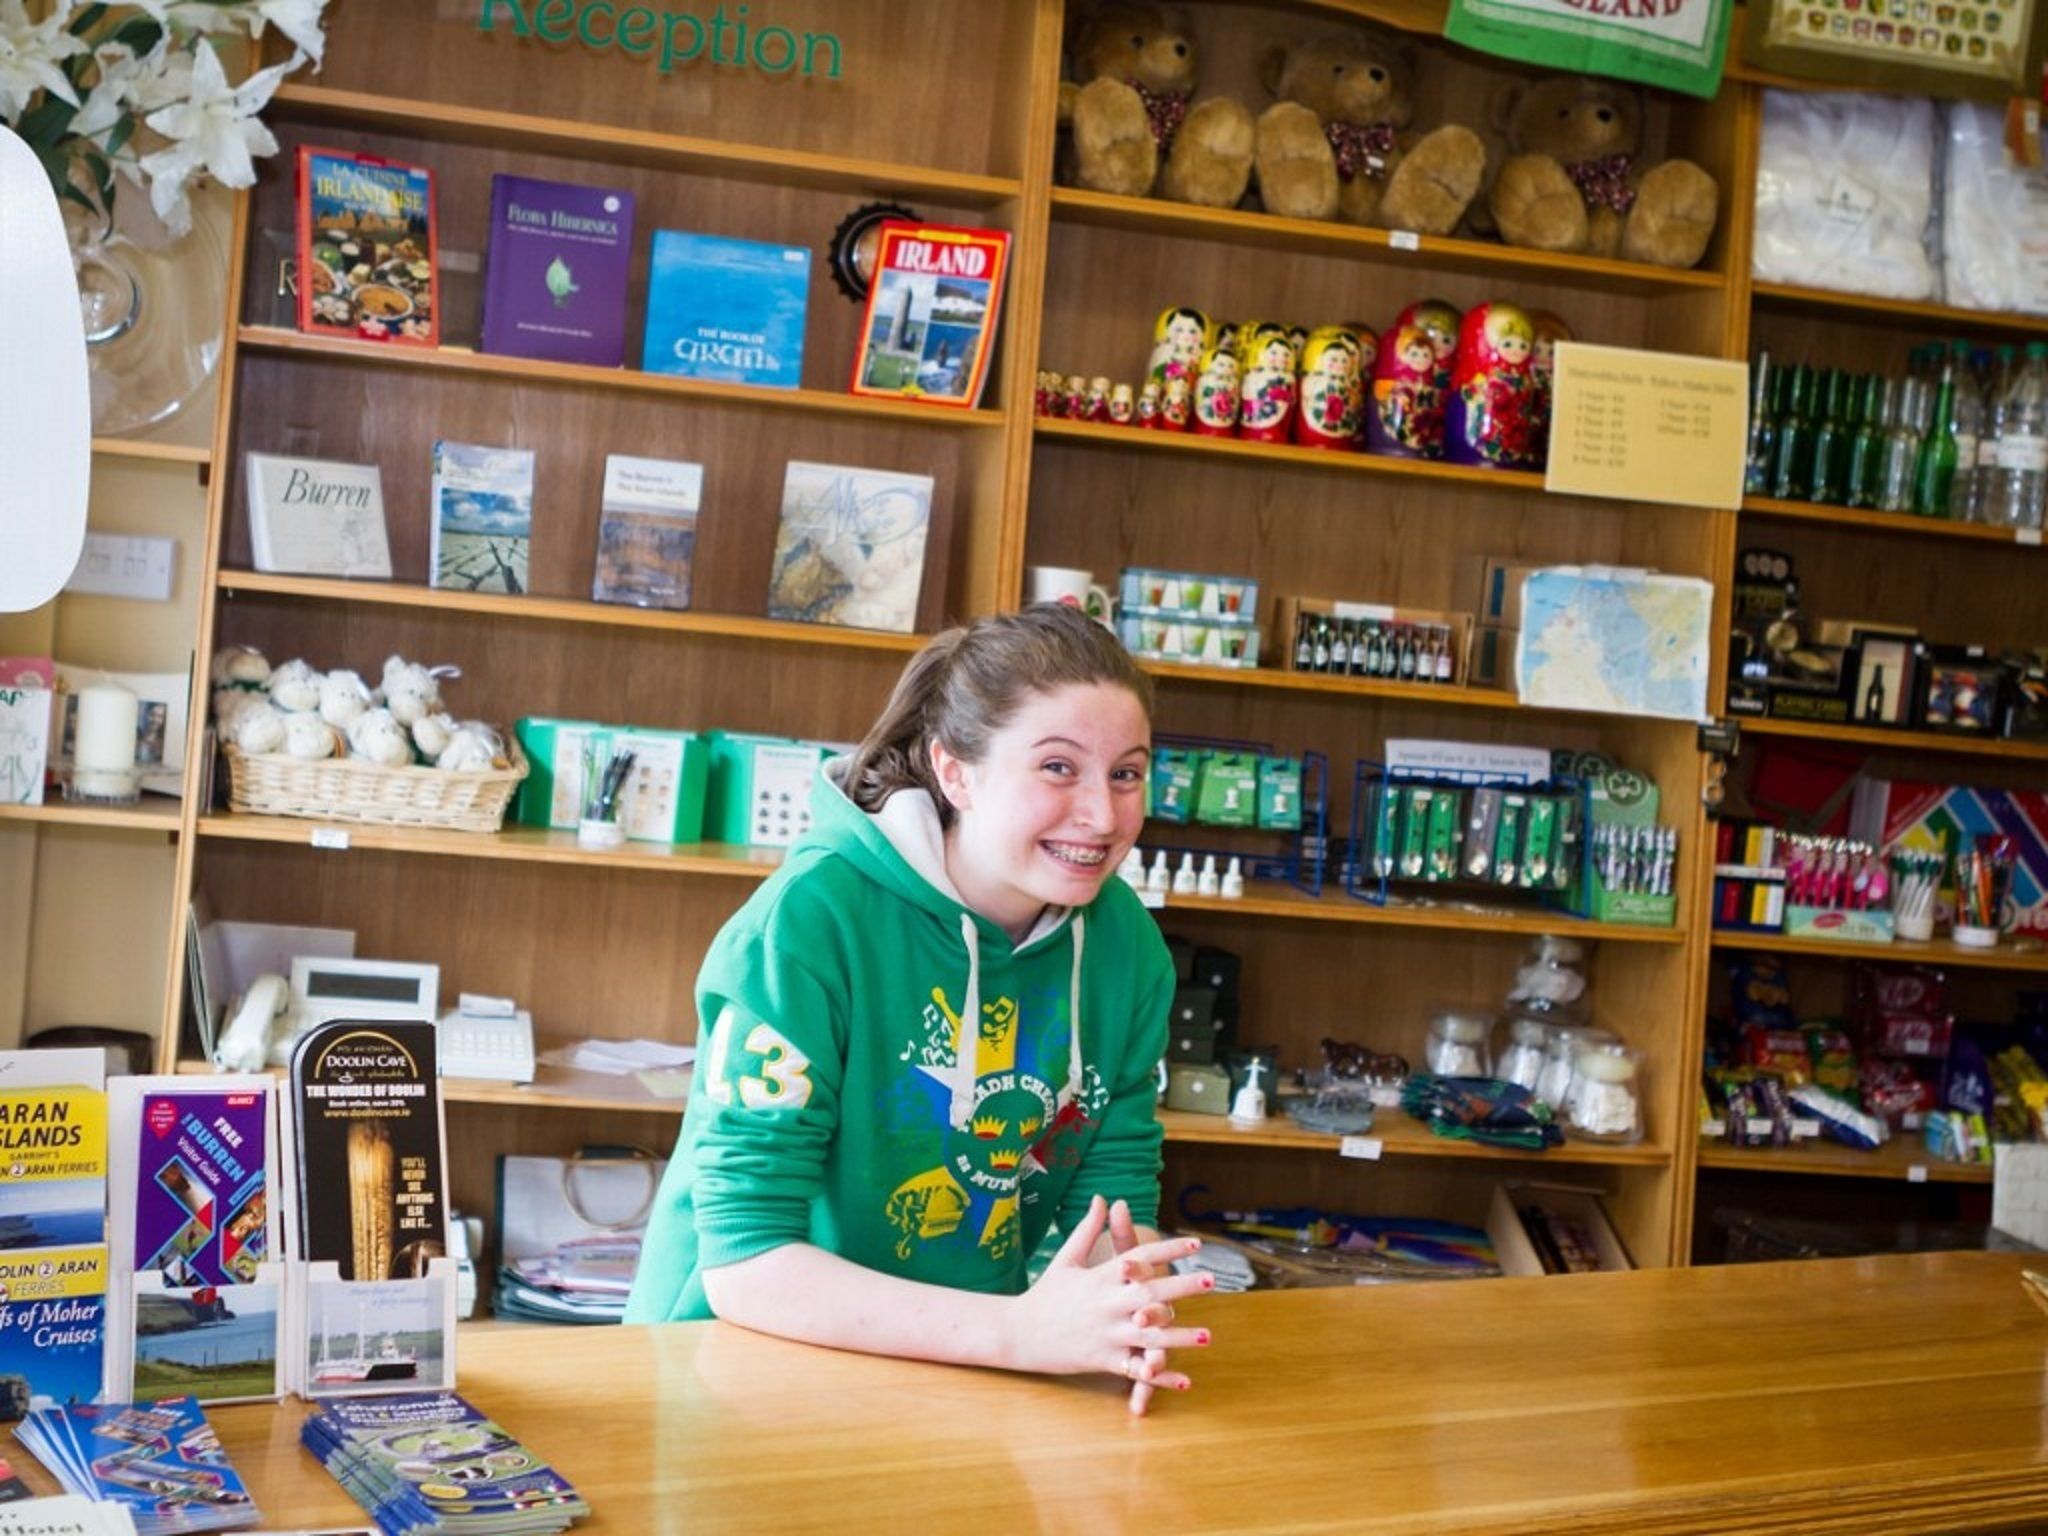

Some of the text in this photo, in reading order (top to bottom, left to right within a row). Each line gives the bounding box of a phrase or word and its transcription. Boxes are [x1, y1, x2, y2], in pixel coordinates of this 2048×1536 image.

[895, 239, 987, 277] IRLAND
[281, 467, 372, 508] Burren
[326, 1054, 408, 1068] DOOLIN CAVE
[306, 1083, 426, 1098] THE WONDER OF DOOLIN
[0, 1101, 69, 1124] ARAN
[0, 1125, 82, 1149] LANDS
[213, 1116, 243, 1148] FREE
[186, 1118, 246, 1182] BURREN
[26, 1163, 55, 1175] ARAN
[58, 1161, 99, 1174] FERRIES
[198, 1160, 222, 1185] Guide
[57, 1260, 97, 1275] ARAN
[17, 1302, 41, 1333] of
[39, 1299, 99, 1325] Moher
[33, 1325, 97, 1348] Cruises
